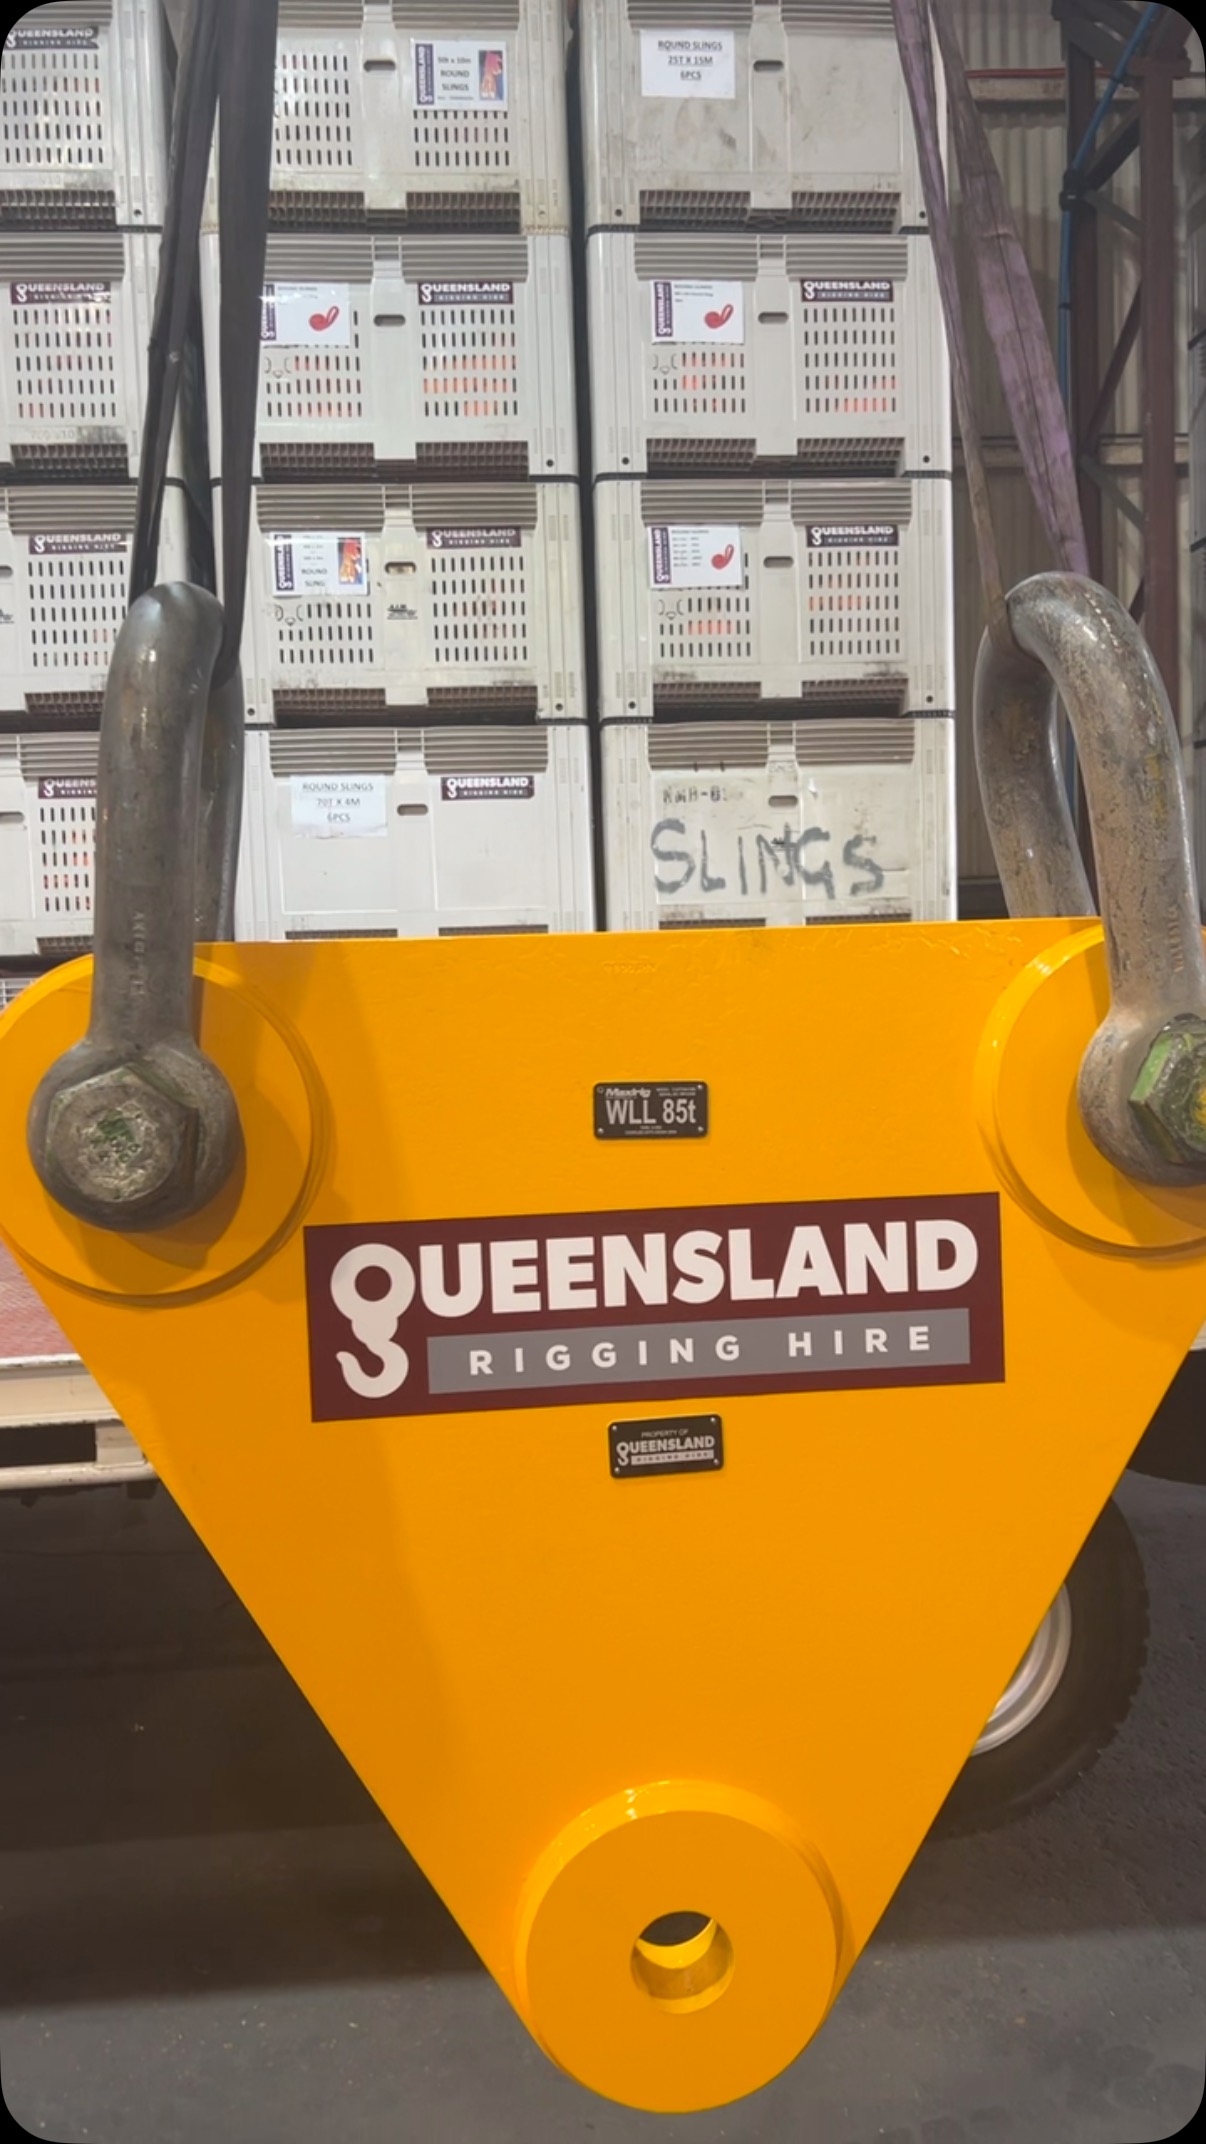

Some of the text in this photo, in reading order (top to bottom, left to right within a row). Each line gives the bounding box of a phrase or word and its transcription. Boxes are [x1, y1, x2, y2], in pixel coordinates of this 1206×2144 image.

[658, 40, 722, 51] ROUND SLINGS
[442, 83, 469, 91] SLINGS
[16, 282, 105, 302] QUEENSLAND
[421, 283, 510, 303] QUEENSLAND
[803, 281, 890, 300] QUEENSLAND
[34, 533, 121, 553] QUEENSLAND
[432, 529, 516, 548] QUEENSLAND
[811, 525, 893, 545] QUEENSLAND
[43, 779, 97, 797] QUEENS
[302, 782, 374, 791] ROUND SLINGS
[446, 777, 529, 798] QUEENSLAND
[650, 817, 885, 900] SLINGS
[606, 1098, 696, 1124] WLL 85t
[330, 1219, 979, 1399] QUEENSLAND
[469, 1326, 930, 1376] RIGGING HIRE
[641, 1428, 689, 1438] PROPERTY OF
[616, 1435, 715, 1466] QUEENSLAND
